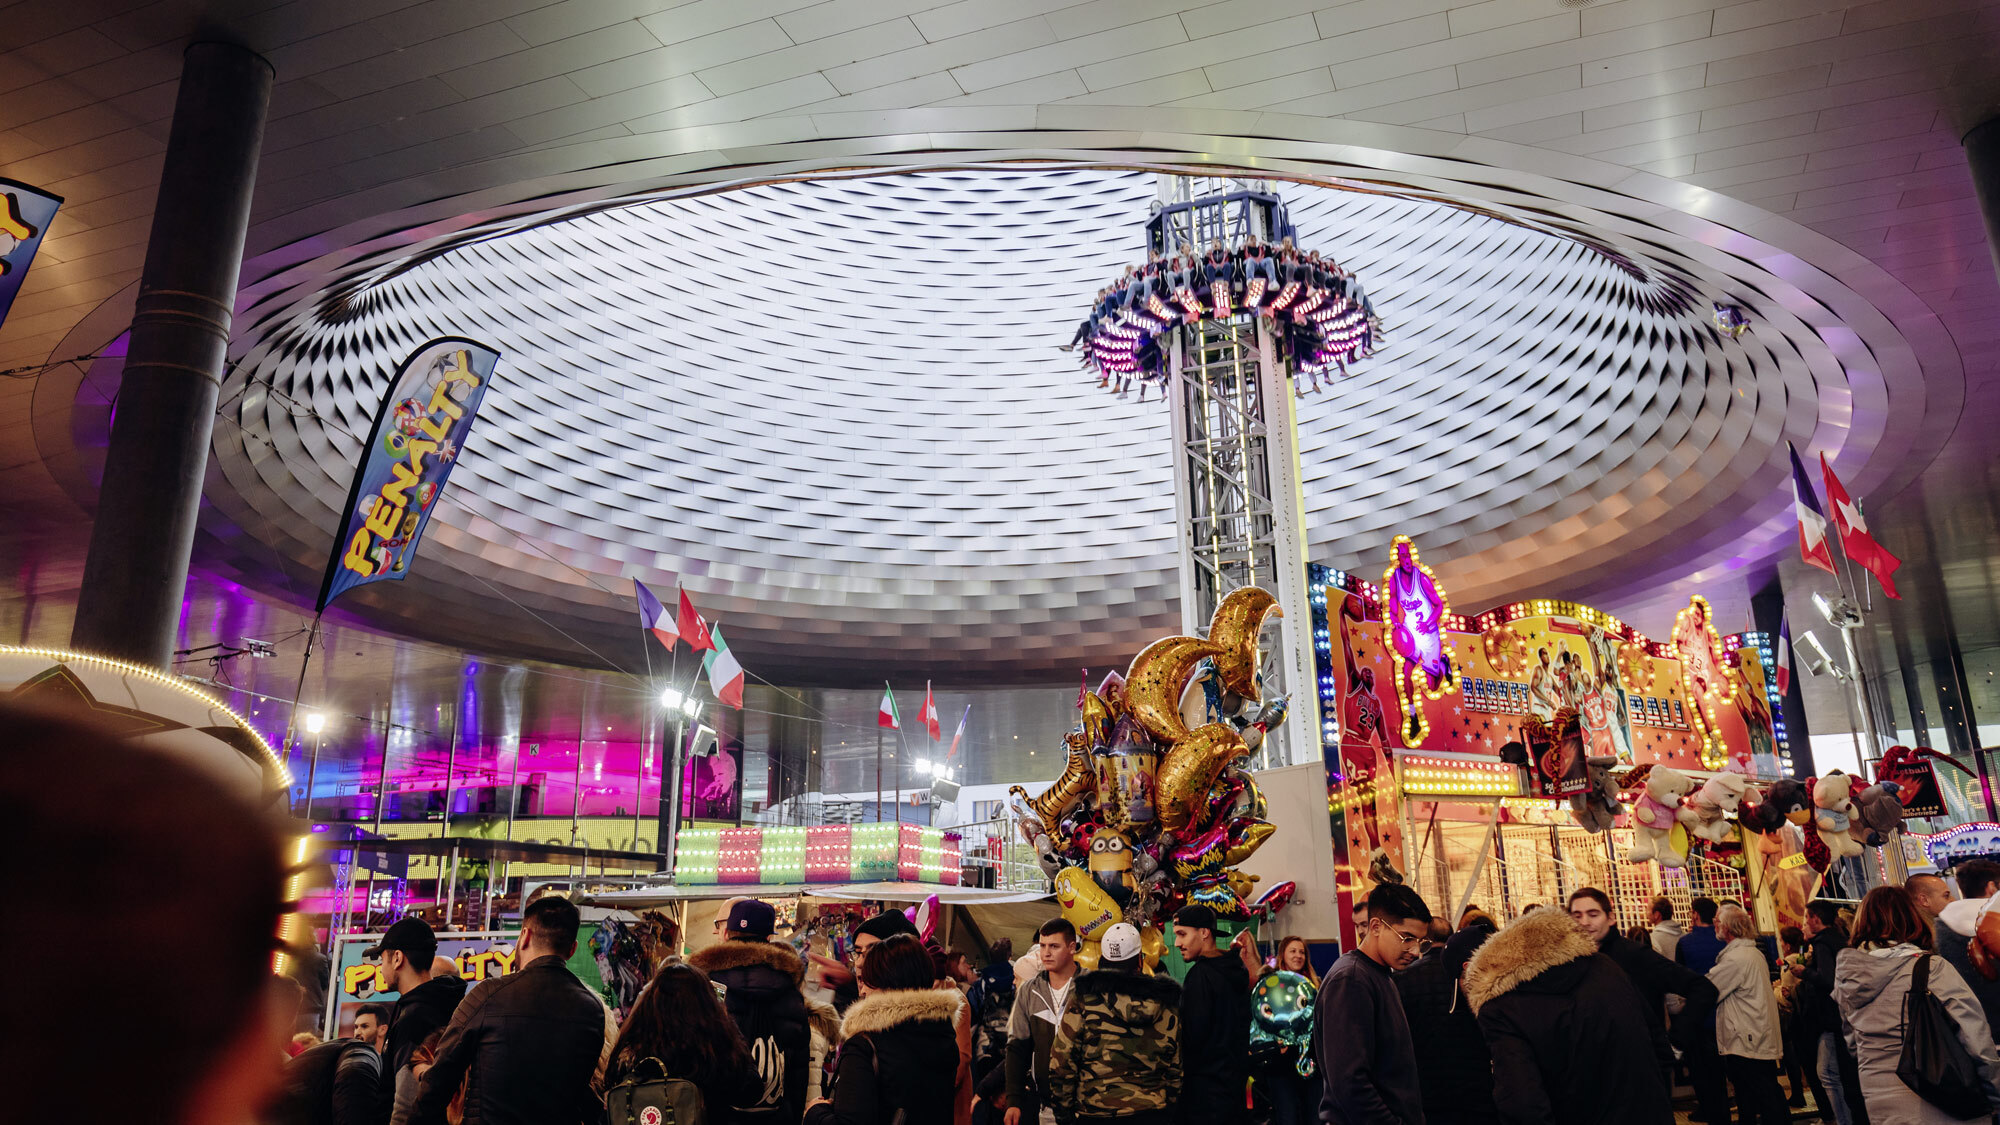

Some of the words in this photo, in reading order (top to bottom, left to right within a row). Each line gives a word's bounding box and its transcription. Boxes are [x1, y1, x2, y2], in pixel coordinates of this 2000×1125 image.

[344, 349, 481, 578] PENALTY
[1359, 707, 1375, 730] 23
[1461, 676, 1530, 716] BASKET
[1629, 695, 1690, 731] BALL
[530, 744, 538, 755] K
[344, 950, 516, 993] PELTY
